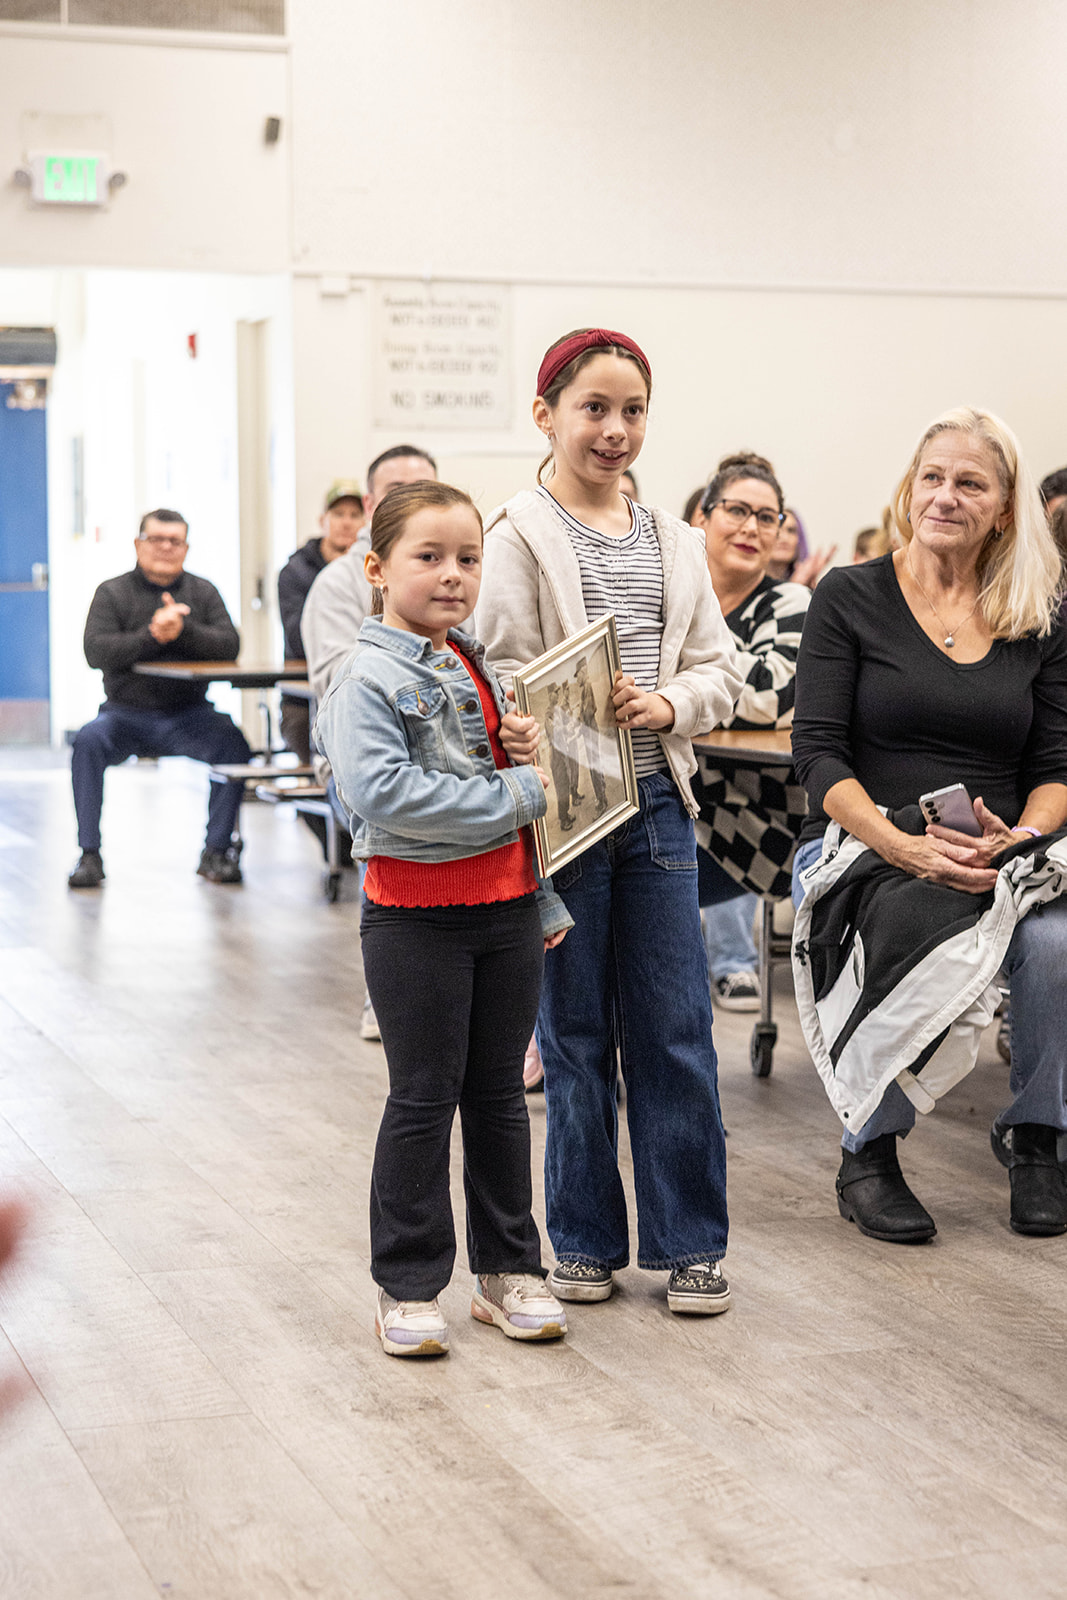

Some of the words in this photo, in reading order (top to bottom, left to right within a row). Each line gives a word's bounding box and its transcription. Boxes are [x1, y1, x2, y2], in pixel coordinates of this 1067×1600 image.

[45, 157, 99, 201] EXIT
[391, 390, 415, 409] NO
[424, 390, 494, 409] SMOKING
